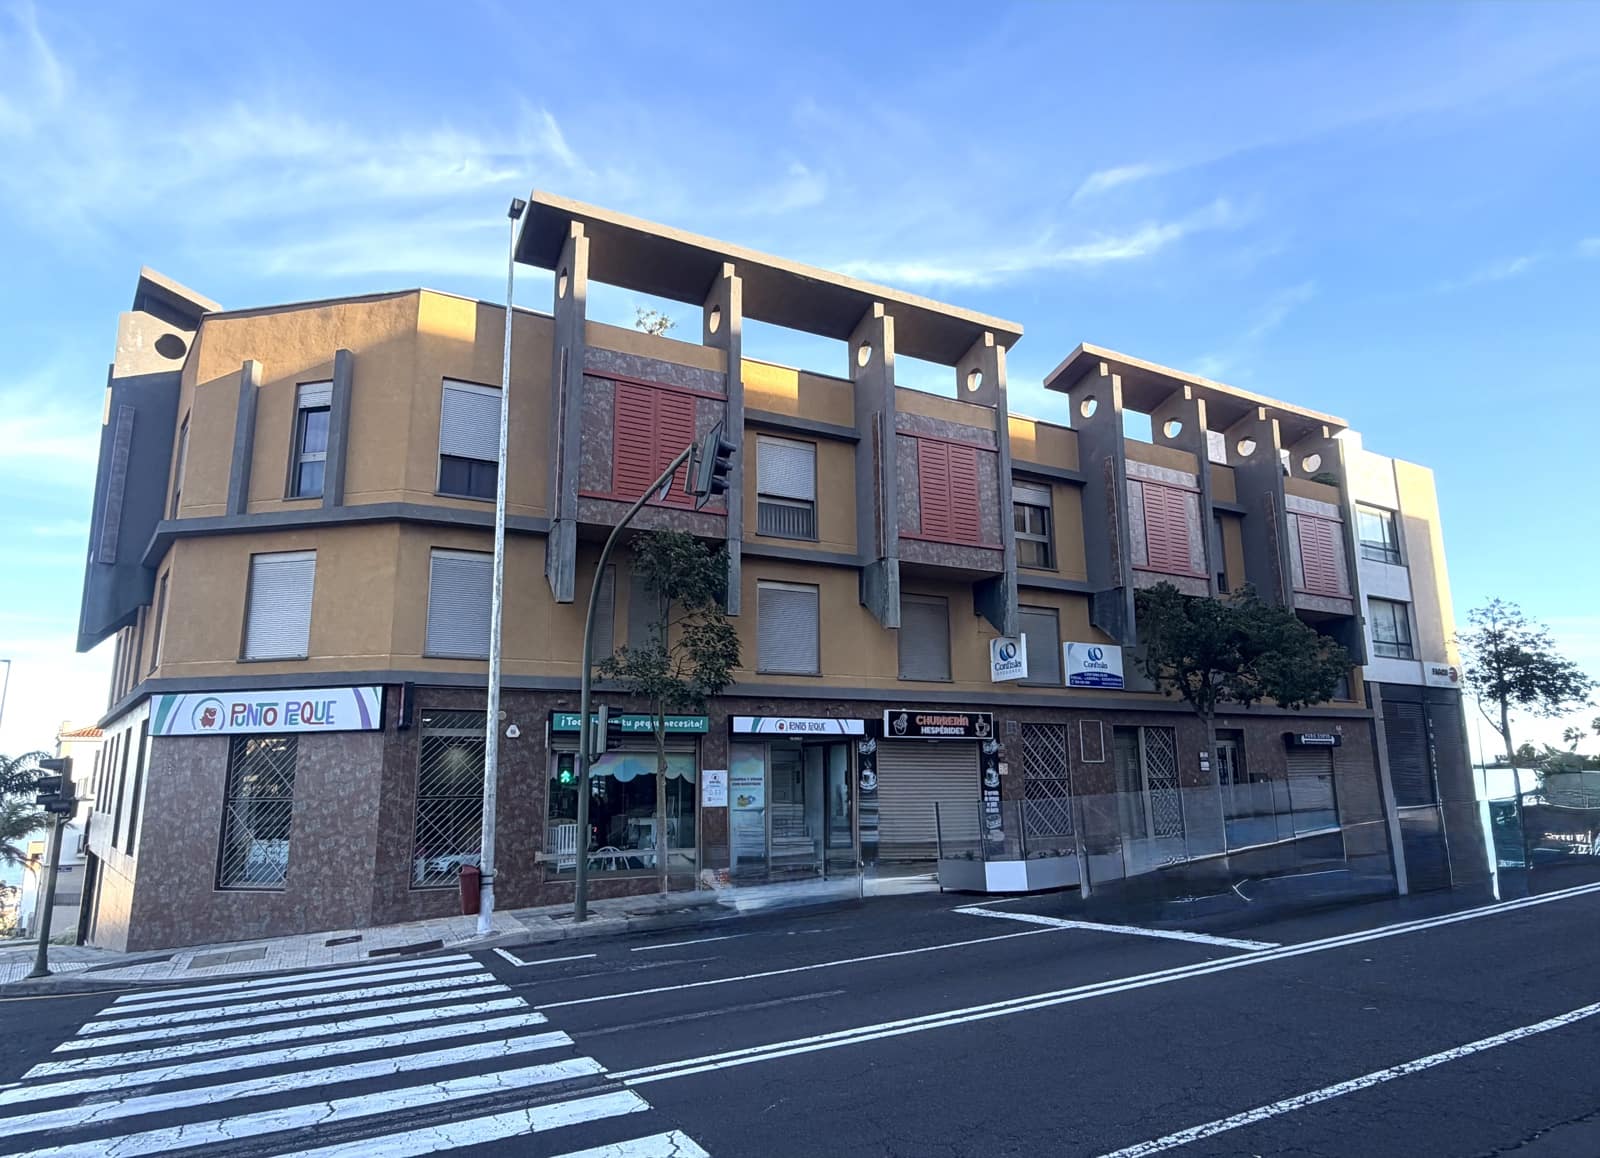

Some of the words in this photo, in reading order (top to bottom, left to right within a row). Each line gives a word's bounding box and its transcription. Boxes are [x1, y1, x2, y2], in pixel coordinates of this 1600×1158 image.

[230, 702, 279, 727] PUNTO
[284, 700, 337, 725] PEQUE
[622, 719, 632, 727] tu
[915, 714, 969, 727] CHURRERÍA
[920, 725, 965, 735] HESPÉRIDES
